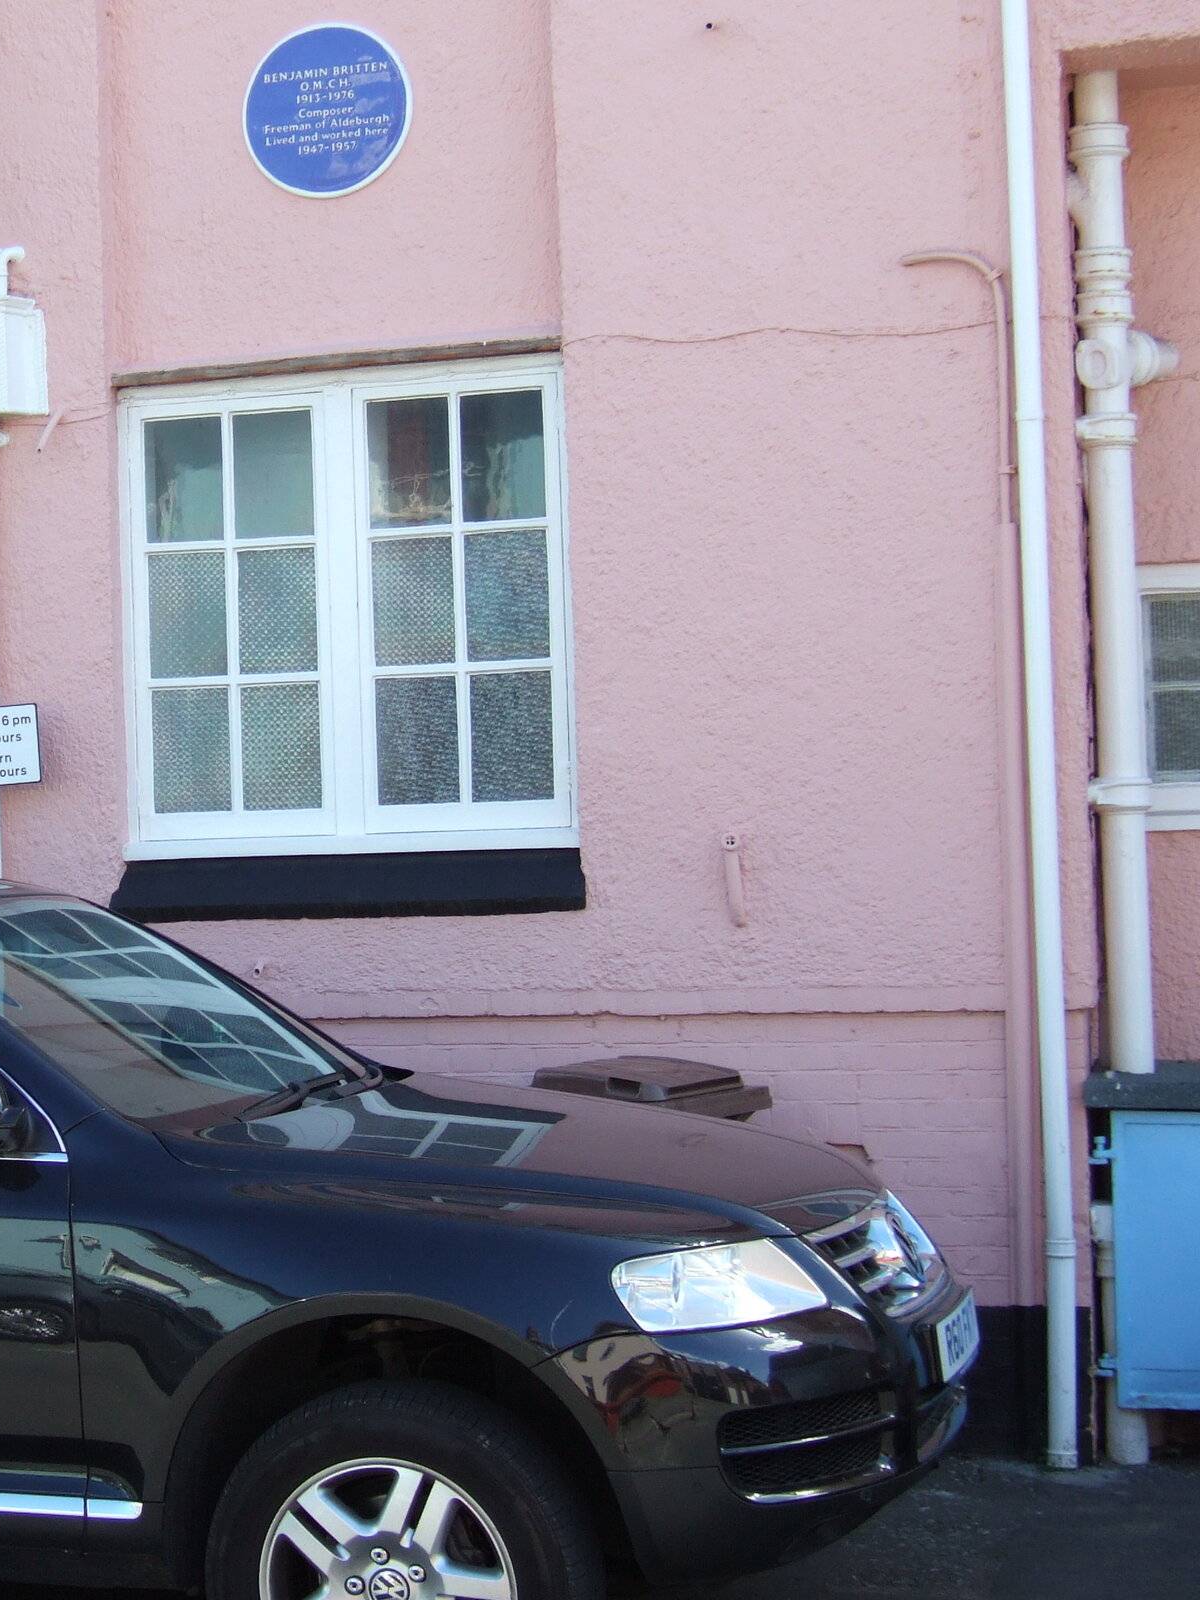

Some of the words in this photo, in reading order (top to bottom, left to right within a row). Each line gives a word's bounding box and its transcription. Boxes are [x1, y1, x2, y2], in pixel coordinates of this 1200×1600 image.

[264, 68, 328, 83] BENJAMIN
[333, 62, 388, 76] BRITTEN
[296, 90, 355, 104] 1913-1976
[299, 106, 353, 118] Composer
[264, 120, 311, 134] Freeman
[315, 119, 326, 129] of
[330, 114, 389, 127] Aldeburgh
[265, 136, 295, 146] Lived
[299, 132, 318, 142] and
[321, 128, 360, 140] worked
[365, 127, 388, 136] here
[298, 141, 357, 155] 1947-1957
